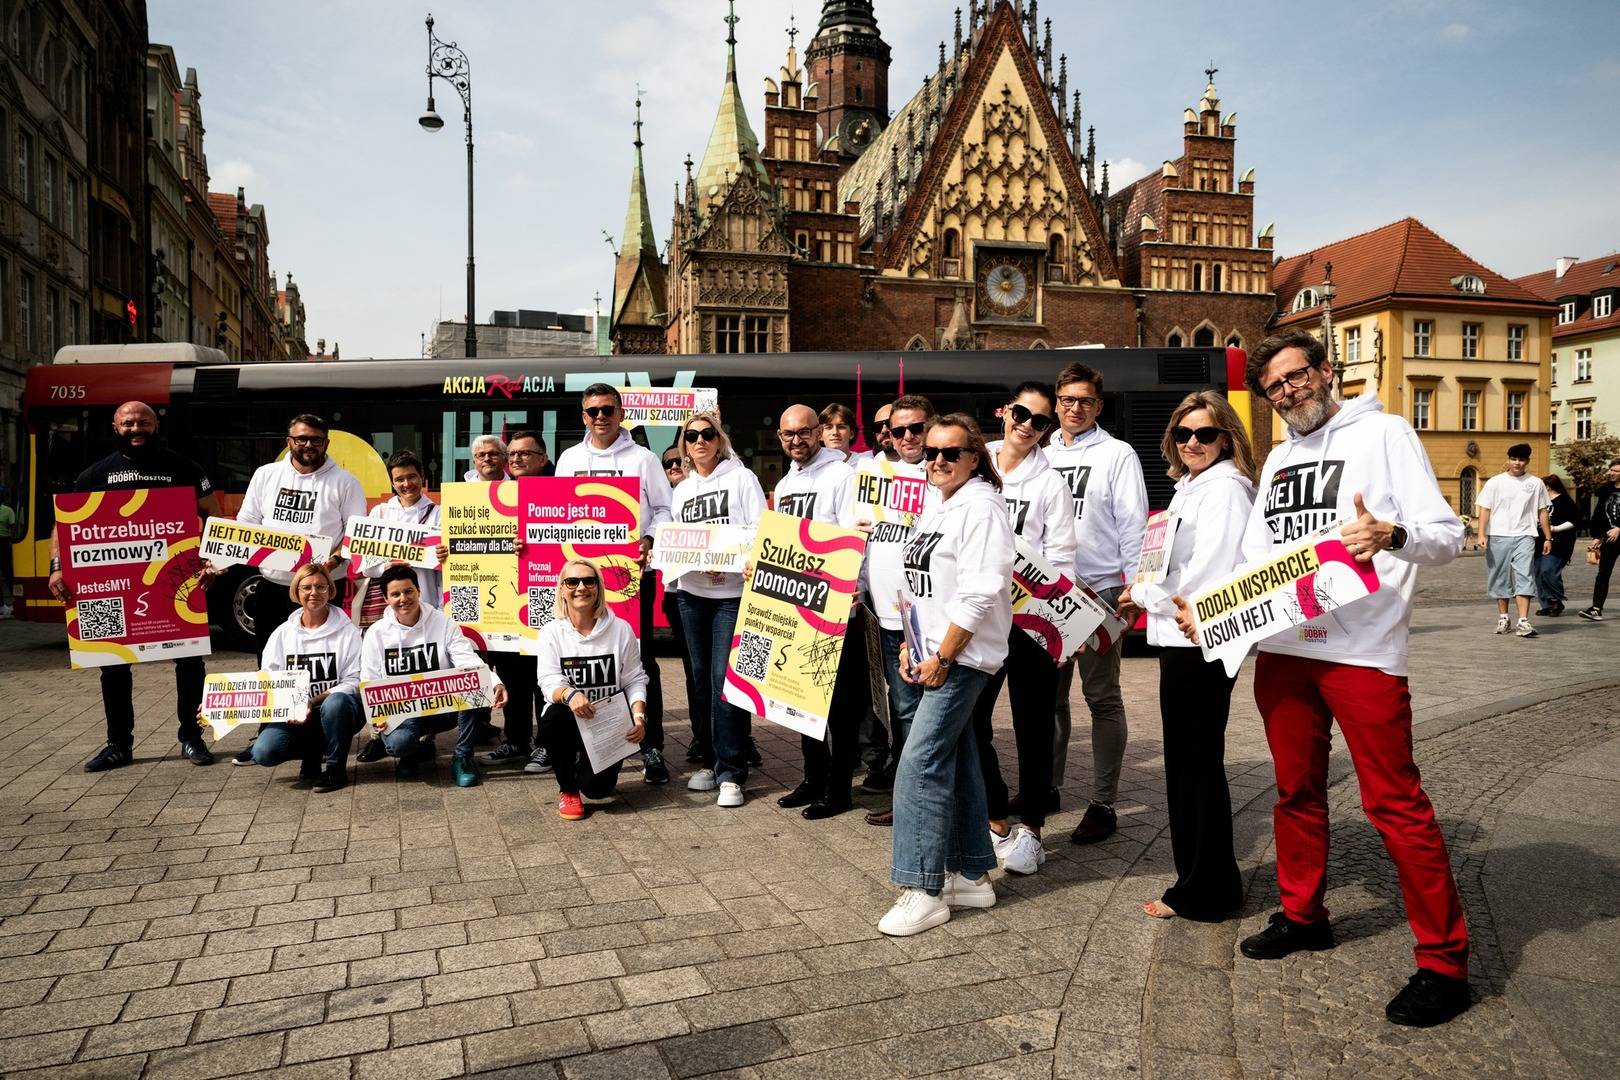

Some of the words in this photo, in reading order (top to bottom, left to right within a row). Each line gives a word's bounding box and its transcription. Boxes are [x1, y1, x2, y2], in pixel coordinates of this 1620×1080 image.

[51, 386, 86, 399] 7035
[443, 376, 486, 393] AKCJA
[668, 394, 691, 408] HEJT,
[650, 408, 692, 421] SZACUNE
[858, 474, 892, 506] HEJT
[892, 478, 924, 513] OFF!
[273, 508, 314, 524] REAGUJ!
[449, 507, 462, 519] Nie
[463, 505, 476, 521] bój
[478, 505, 490, 519] się
[528, 503, 566, 517] Pomoc
[567, 505, 589, 520] jest
[592, 508, 606, 517] na
[71, 519, 185, 541] Potrzebujesz
[209, 524, 236, 541] HEJT
[238, 529, 252, 543] TO
[253, 532, 303, 553] SŁABOŚĆ,
[353, 523, 385, 540] HEJT
[388, 528, 404, 543] TO
[407, 530, 428, 546] NIE
[449, 523, 478, 537] szukać
[480, 522, 518, 538] wsparcia
[529, 526, 600, 545] wyciągnięcie
[604, 525, 627, 544] ręki
[661, 530, 709, 548] SŁOWA
[73, 541, 164, 564] rozmowy?
[205, 540, 224, 556] NIE
[226, 543, 250, 560] SIŁA
[350, 539, 425, 562] CHALLENGE
[456, 539, 487, 554] działamy
[489, 539, 500, 552] dla
[660, 550, 701, 566] TWORZĄ
[703, 550, 737, 566] ŚWIAT
[760, 538, 826, 576] Szukasz
[449, 562, 469, 574] Zobacz,
[470, 562, 480, 574] jak
[528, 561, 553, 576] Poznaj
[77, 579, 131, 595] JesteśMY!
[449, 573, 472, 585] możemy
[473, 572, 479, 583] Ci
[480, 572, 500, 585] pomóc:
[753, 568, 829, 607] pomocy?
[1019, 562, 1052, 595] NIE
[1196, 582, 1239, 622] DODAJ
[1238, 549, 1320, 602] WSPARCIE,
[746, 602, 772, 621] Sprawdź
[772, 611, 799, 630] miejskie
[1203, 612, 1241, 649] USUŃ
[1240, 600, 1275, 634] HEJT
[744, 616, 767, 634] punkty
[766, 622, 796, 641] wsparcia!
[388, 645, 437, 673] HEJTY
[208, 681, 227, 692] TWÓJ
[228, 680, 247, 692] DZIEŃ
[248, 680, 257, 690] TO
[259, 679, 296, 691] DOKŁADNIE
[367, 683, 410, 704] KLIKNIJ
[411, 673, 479, 699] ŻYCZLIWOŚĆ
[207, 694, 232, 708] 1440
[234, 692, 267, 707] MINUT
[370, 699, 418, 718] ZAMIAST
[420, 695, 454, 711] HEJTU
[210, 710, 222, 720] NIE
[223, 709, 250, 720] MARNUJ
[251, 709, 261, 719] GO
[262, 709, 272, 718] NA
[273, 708, 290, 718] HEJT
